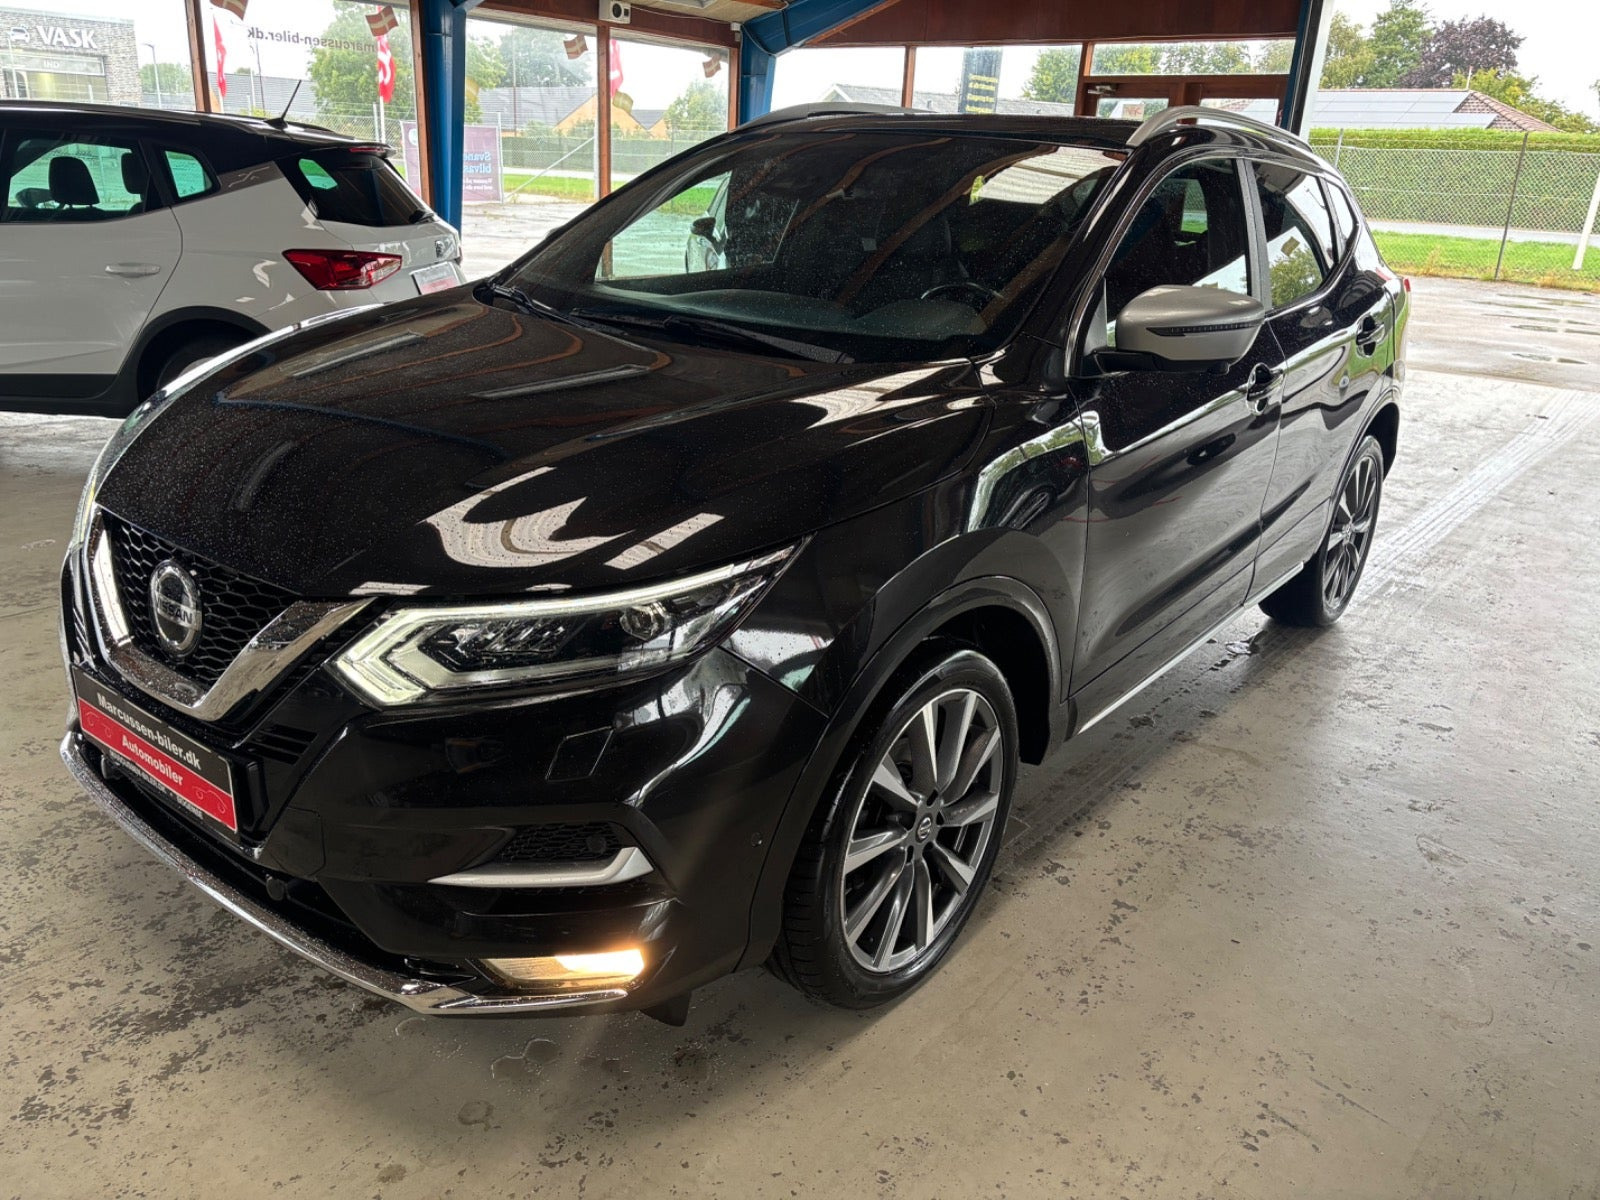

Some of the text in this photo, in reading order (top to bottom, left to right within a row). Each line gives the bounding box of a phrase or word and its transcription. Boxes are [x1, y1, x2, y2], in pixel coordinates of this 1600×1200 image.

[36, 25, 98, 49] VASK
[97, 693, 201, 770] Marcussen-biler.dk
[122, 734, 183, 786] Automobiler
